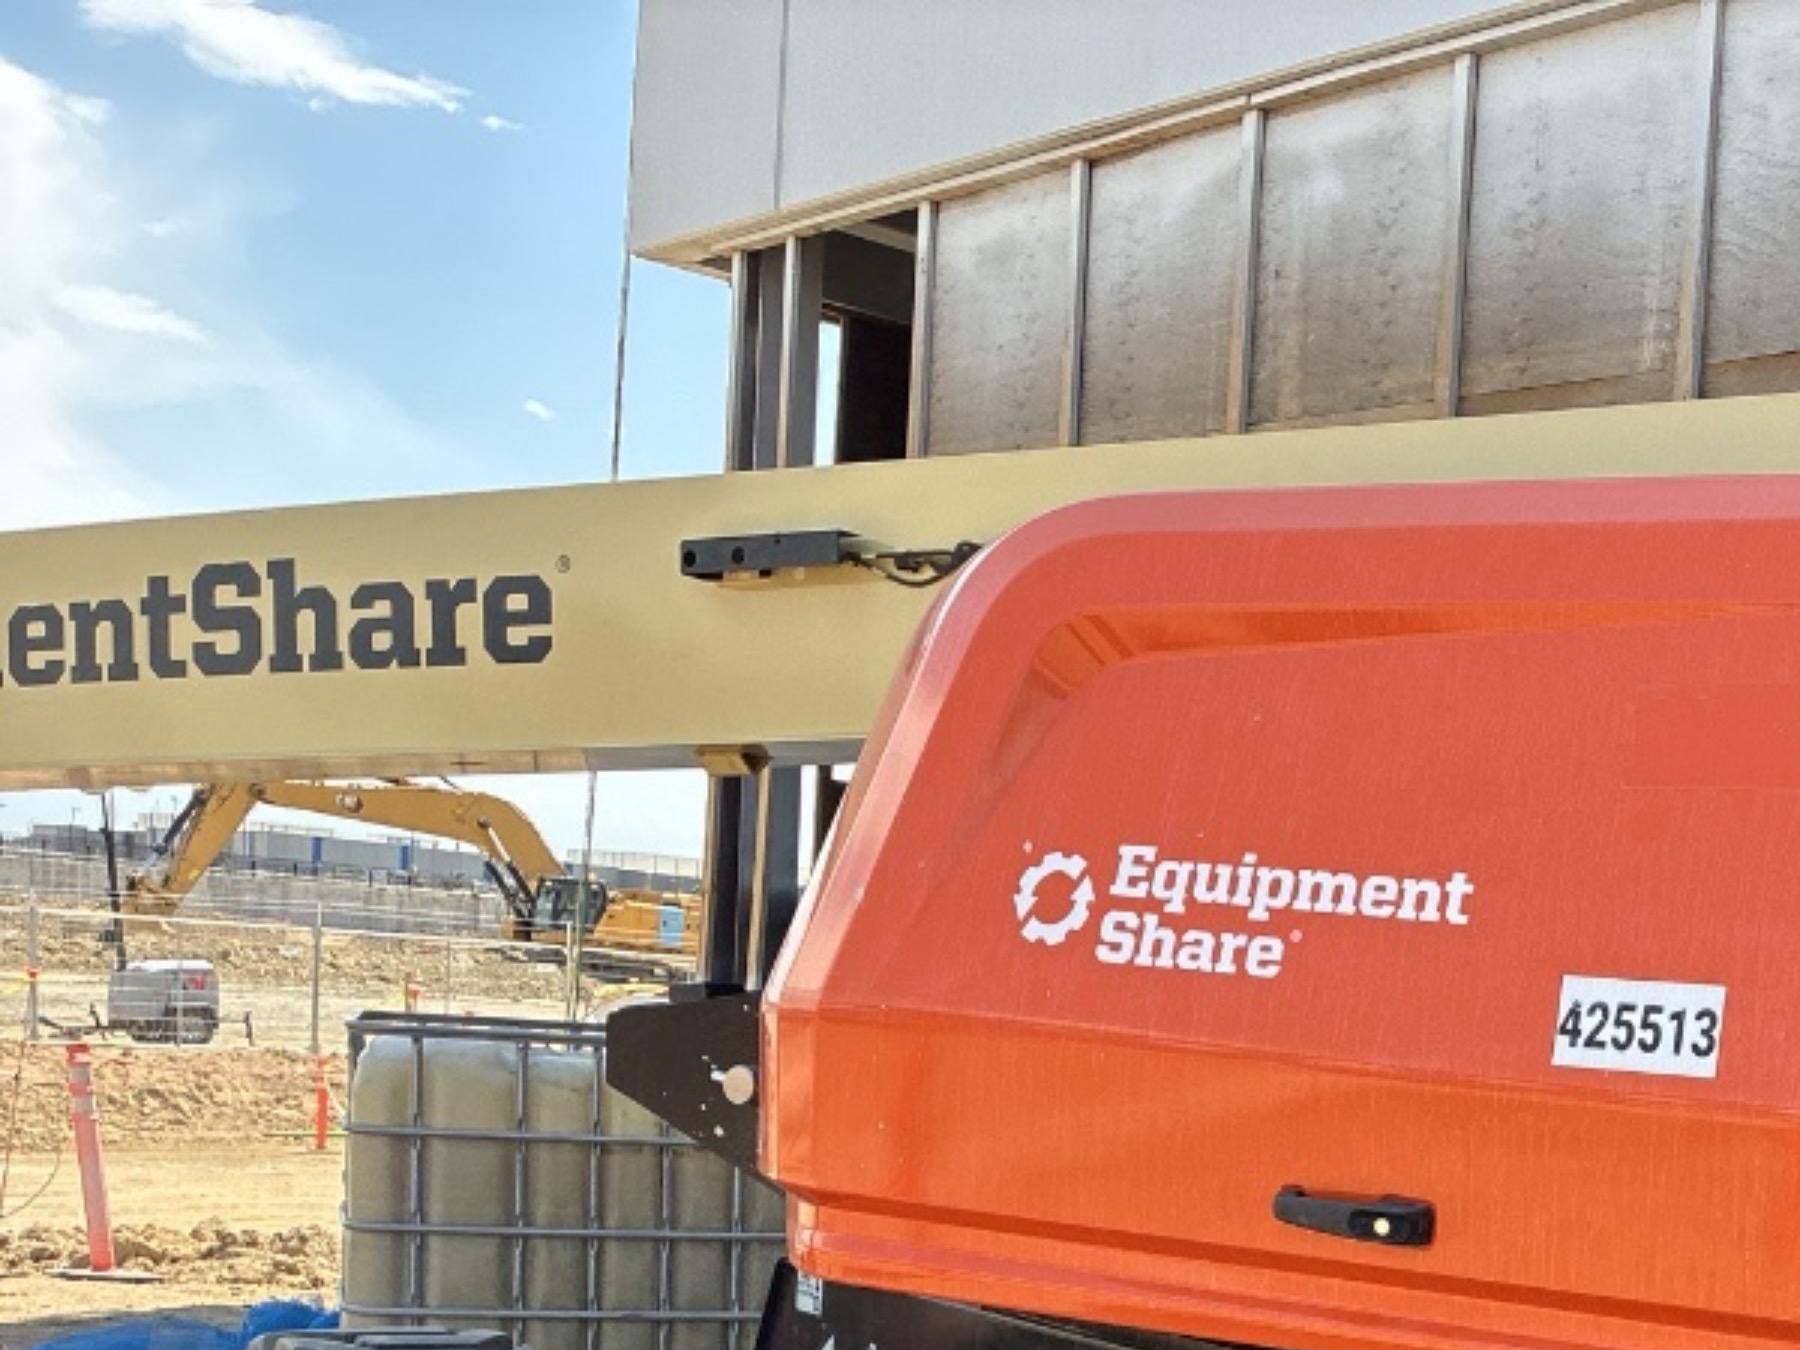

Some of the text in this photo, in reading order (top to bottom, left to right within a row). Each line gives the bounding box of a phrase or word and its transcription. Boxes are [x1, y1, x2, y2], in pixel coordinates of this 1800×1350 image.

[0, 557, 554, 688] entShare
[1109, 844, 1475, 925] Equipment
[1095, 910, 1286, 979] Share
[1558, 999, 1719, 1058] 425513
